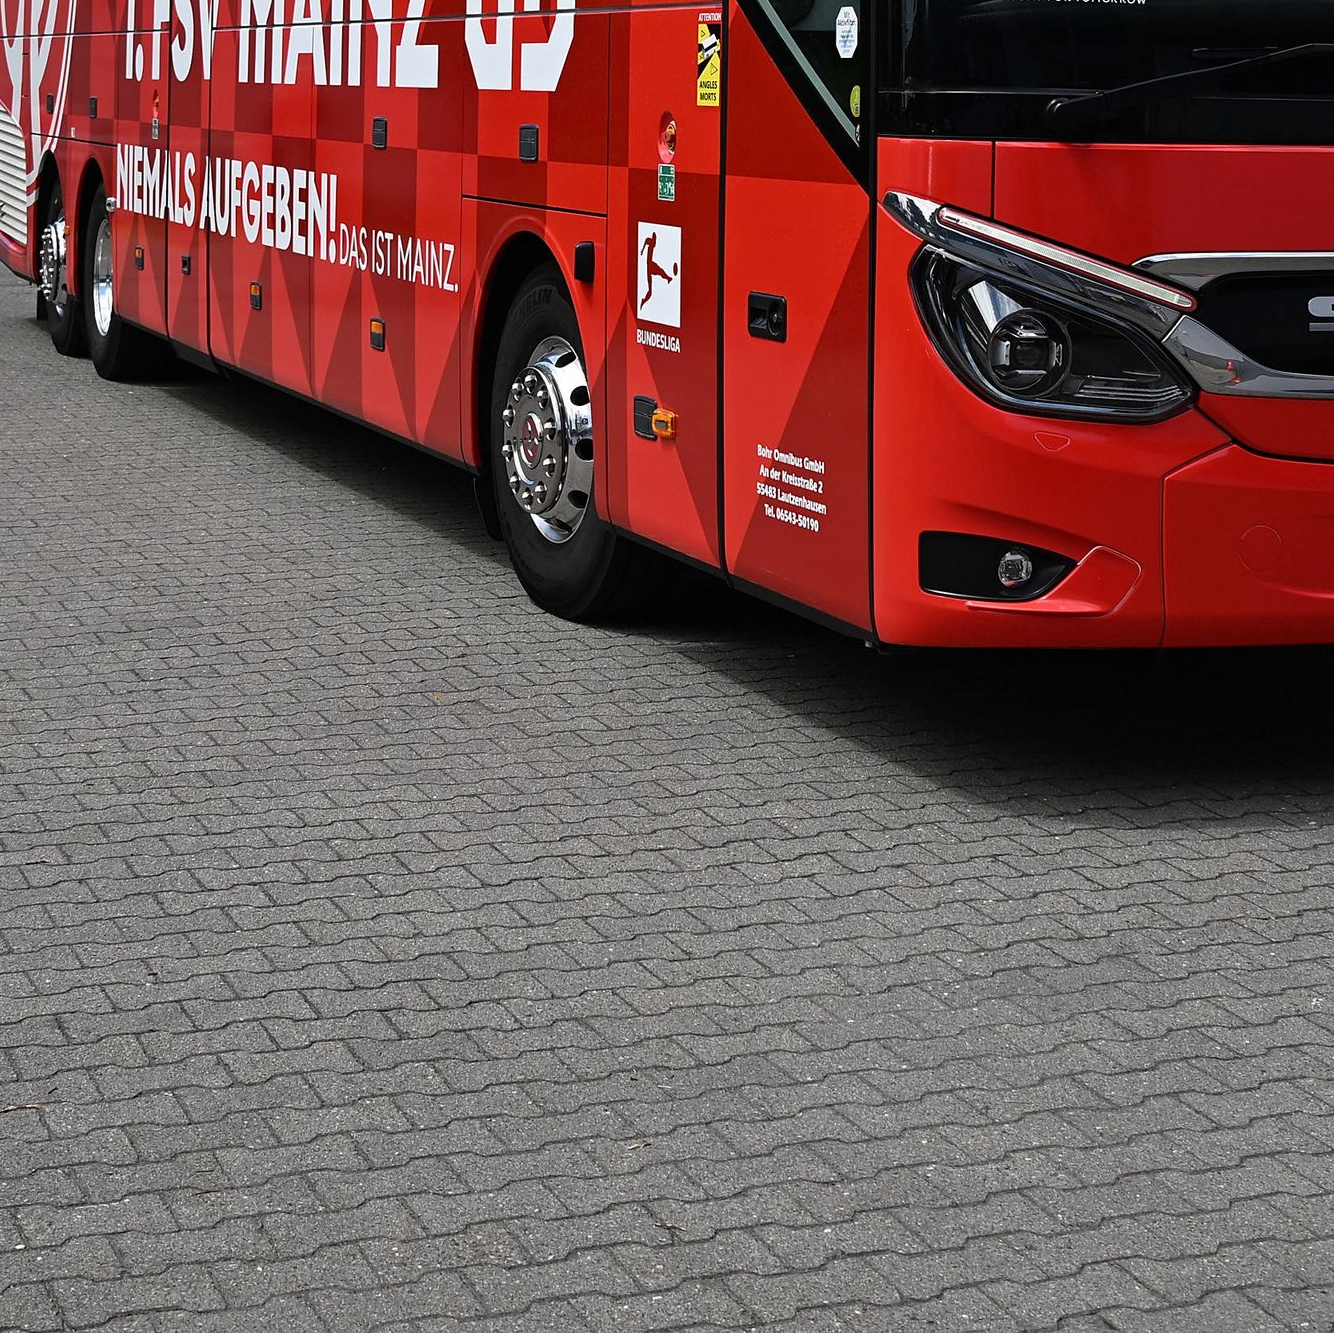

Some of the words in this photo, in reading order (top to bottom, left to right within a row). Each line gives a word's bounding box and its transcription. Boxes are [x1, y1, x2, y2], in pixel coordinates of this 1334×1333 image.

[698, 12, 722, 22] ATTENTION
[699, 80, 718, 90] ANGLES
[699, 92, 717, 102] MORTS
[116, 143, 196, 228] NIEMALS
[200, 155, 338, 263] AUFGEBEN!
[339, 223, 368, 271] DAS
[371, 232, 393, 276] IST
[397, 237, 459, 293] MAINZ.
[636, 328, 682, 354] BUNDESLIGA
[757, 444, 773, 459] Bohr
[774, 449, 803, 468] Omnibus
[804, 457, 825, 474] GmbH
[760, 464, 769, 478] An
[770, 467, 781, 481] der
[782, 470, 817, 493] Kreisstraße
[818, 481, 823, 494] 2
[756, 482, 777, 499] 55483
[777, 488, 827, 515] Lautzenhausen
[764, 503, 776, 518] Tel.
[776, 507, 819, 532] 06543-50190
